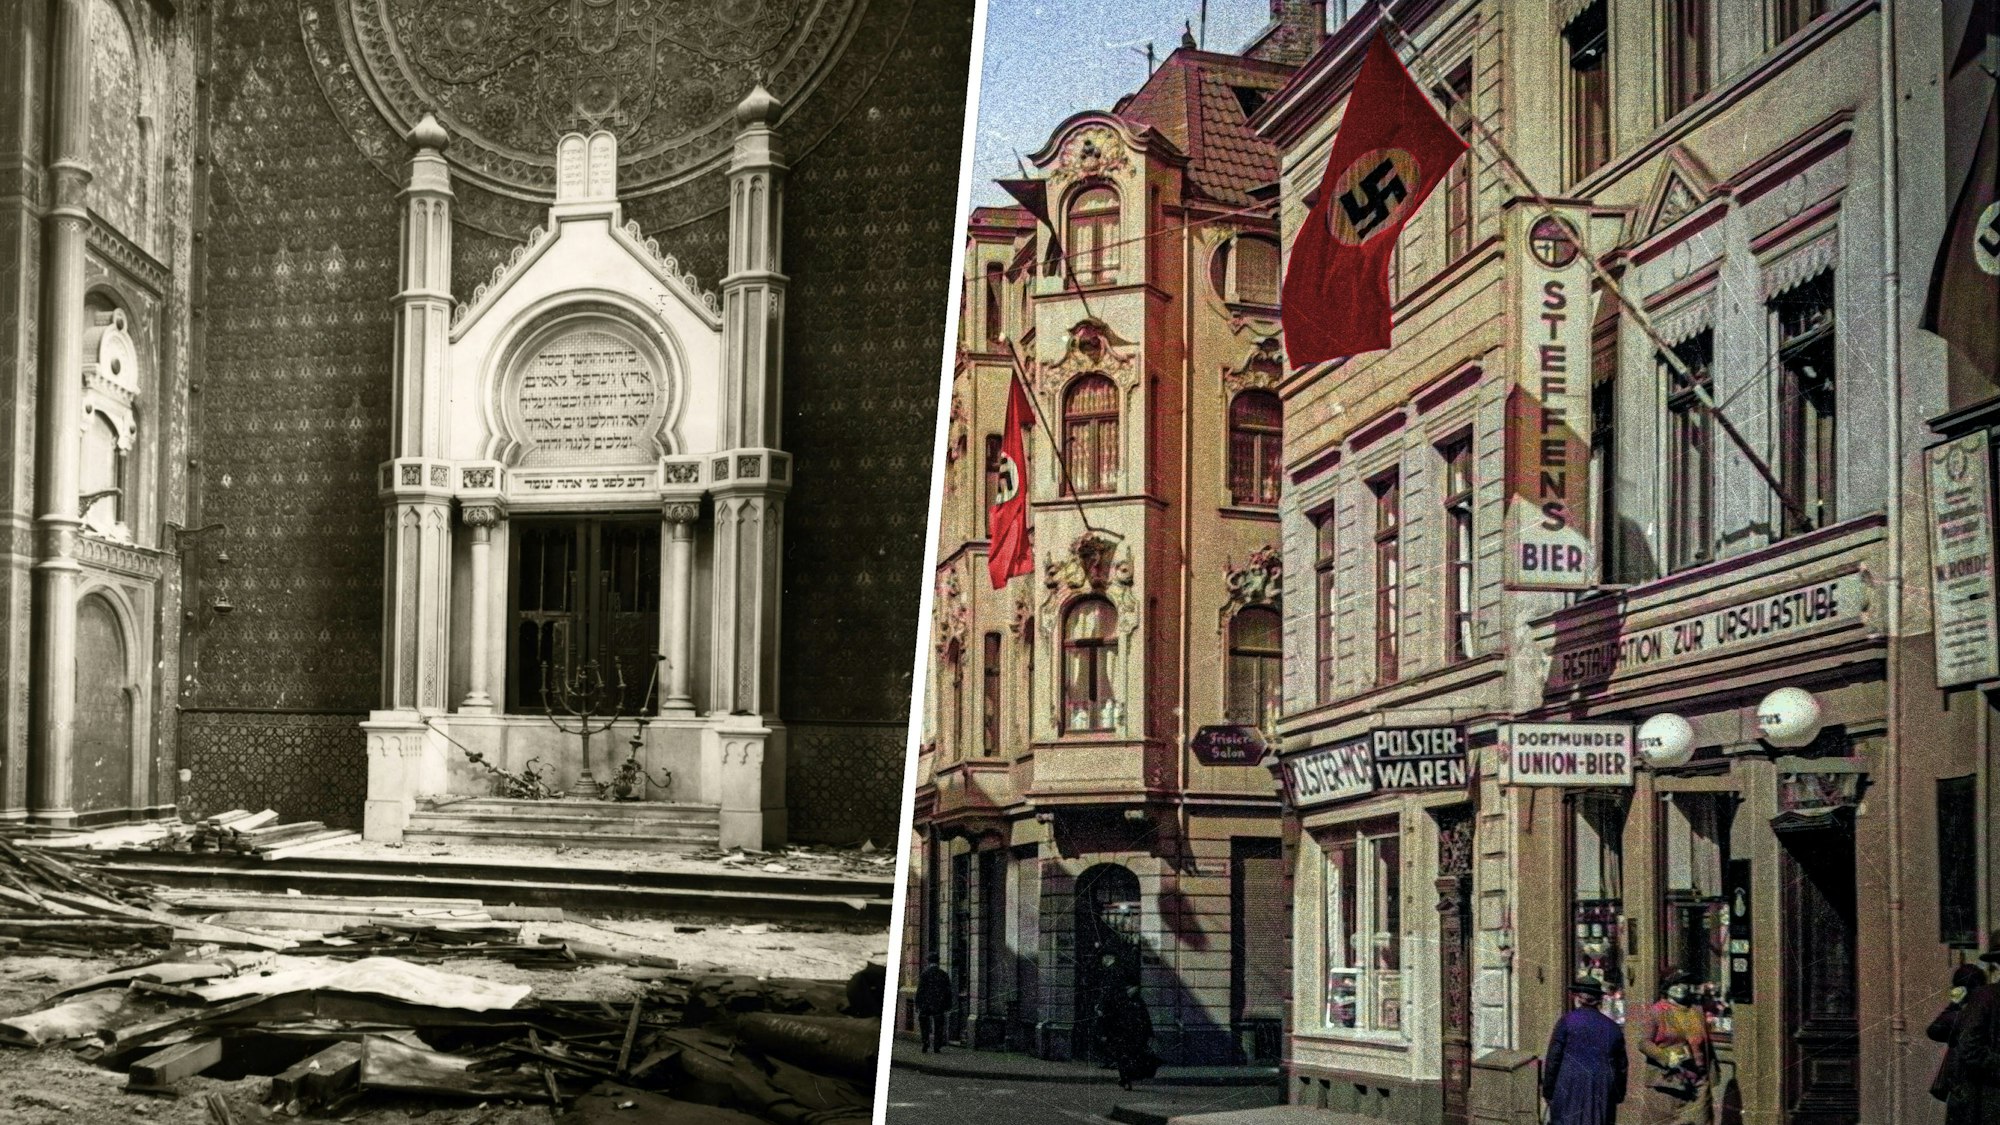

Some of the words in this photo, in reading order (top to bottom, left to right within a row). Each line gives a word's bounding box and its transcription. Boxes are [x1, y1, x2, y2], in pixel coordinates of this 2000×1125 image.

[621, 371, 651, 388] ארץ
[1541, 280, 1567, 532] STEFFENS
[557, 478, 582, 489] אתה
[602, 474, 624, 488] לפני
[627, 477, 645, 488] דע
[1522, 543, 1582, 573] BIER
[1562, 631, 1662, 683] RESTAURATION
[1672, 620, 1704, 655] ZUR
[1716, 583, 1839, 644] URSULASTUBE
[1517, 732, 1625, 747] DORTMUNDER
[1519, 751, 1626, 776] UNION-BIER
[1376, 759, 1466, 790] WAREN
